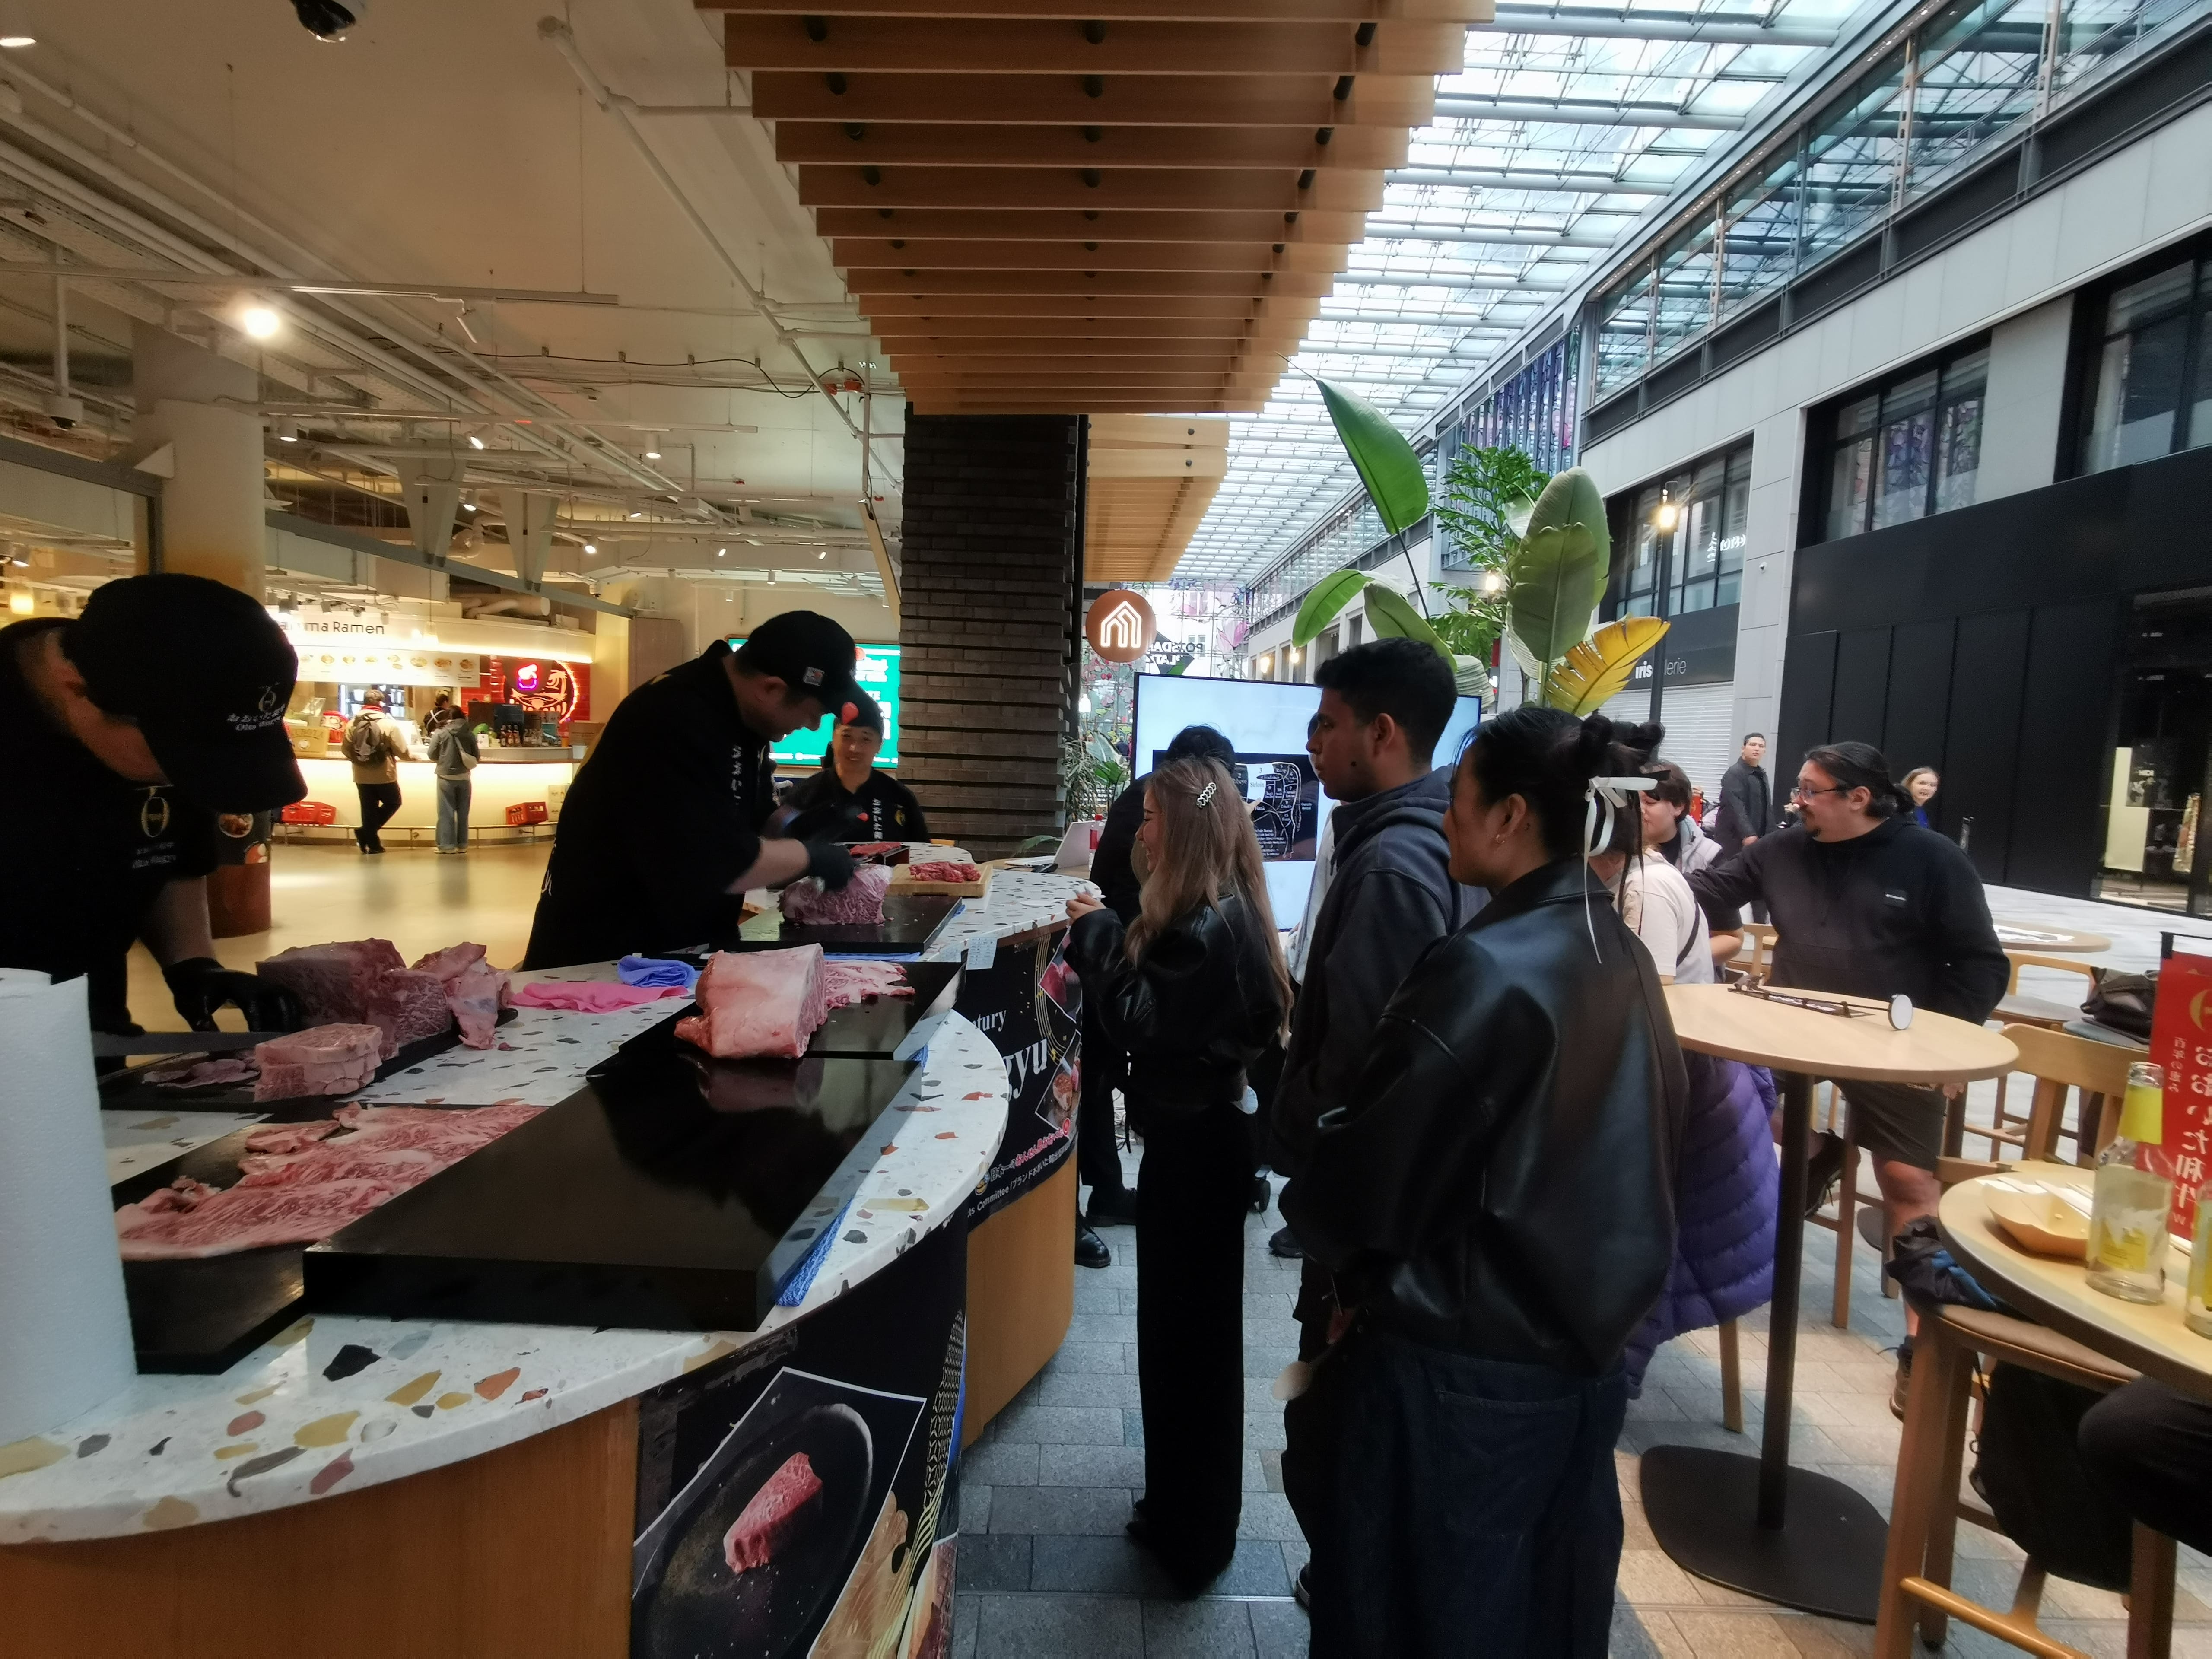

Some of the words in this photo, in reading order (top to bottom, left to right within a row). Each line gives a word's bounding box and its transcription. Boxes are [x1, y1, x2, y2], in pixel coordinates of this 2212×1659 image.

[333, 621, 384, 634] Ramen
[1665, 657, 1687, 675] lerie
[973, 1010, 1007, 1032] tury
[1002, 1037, 1047, 1102] gyu
[977, 1186, 1010, 1211] Committee
